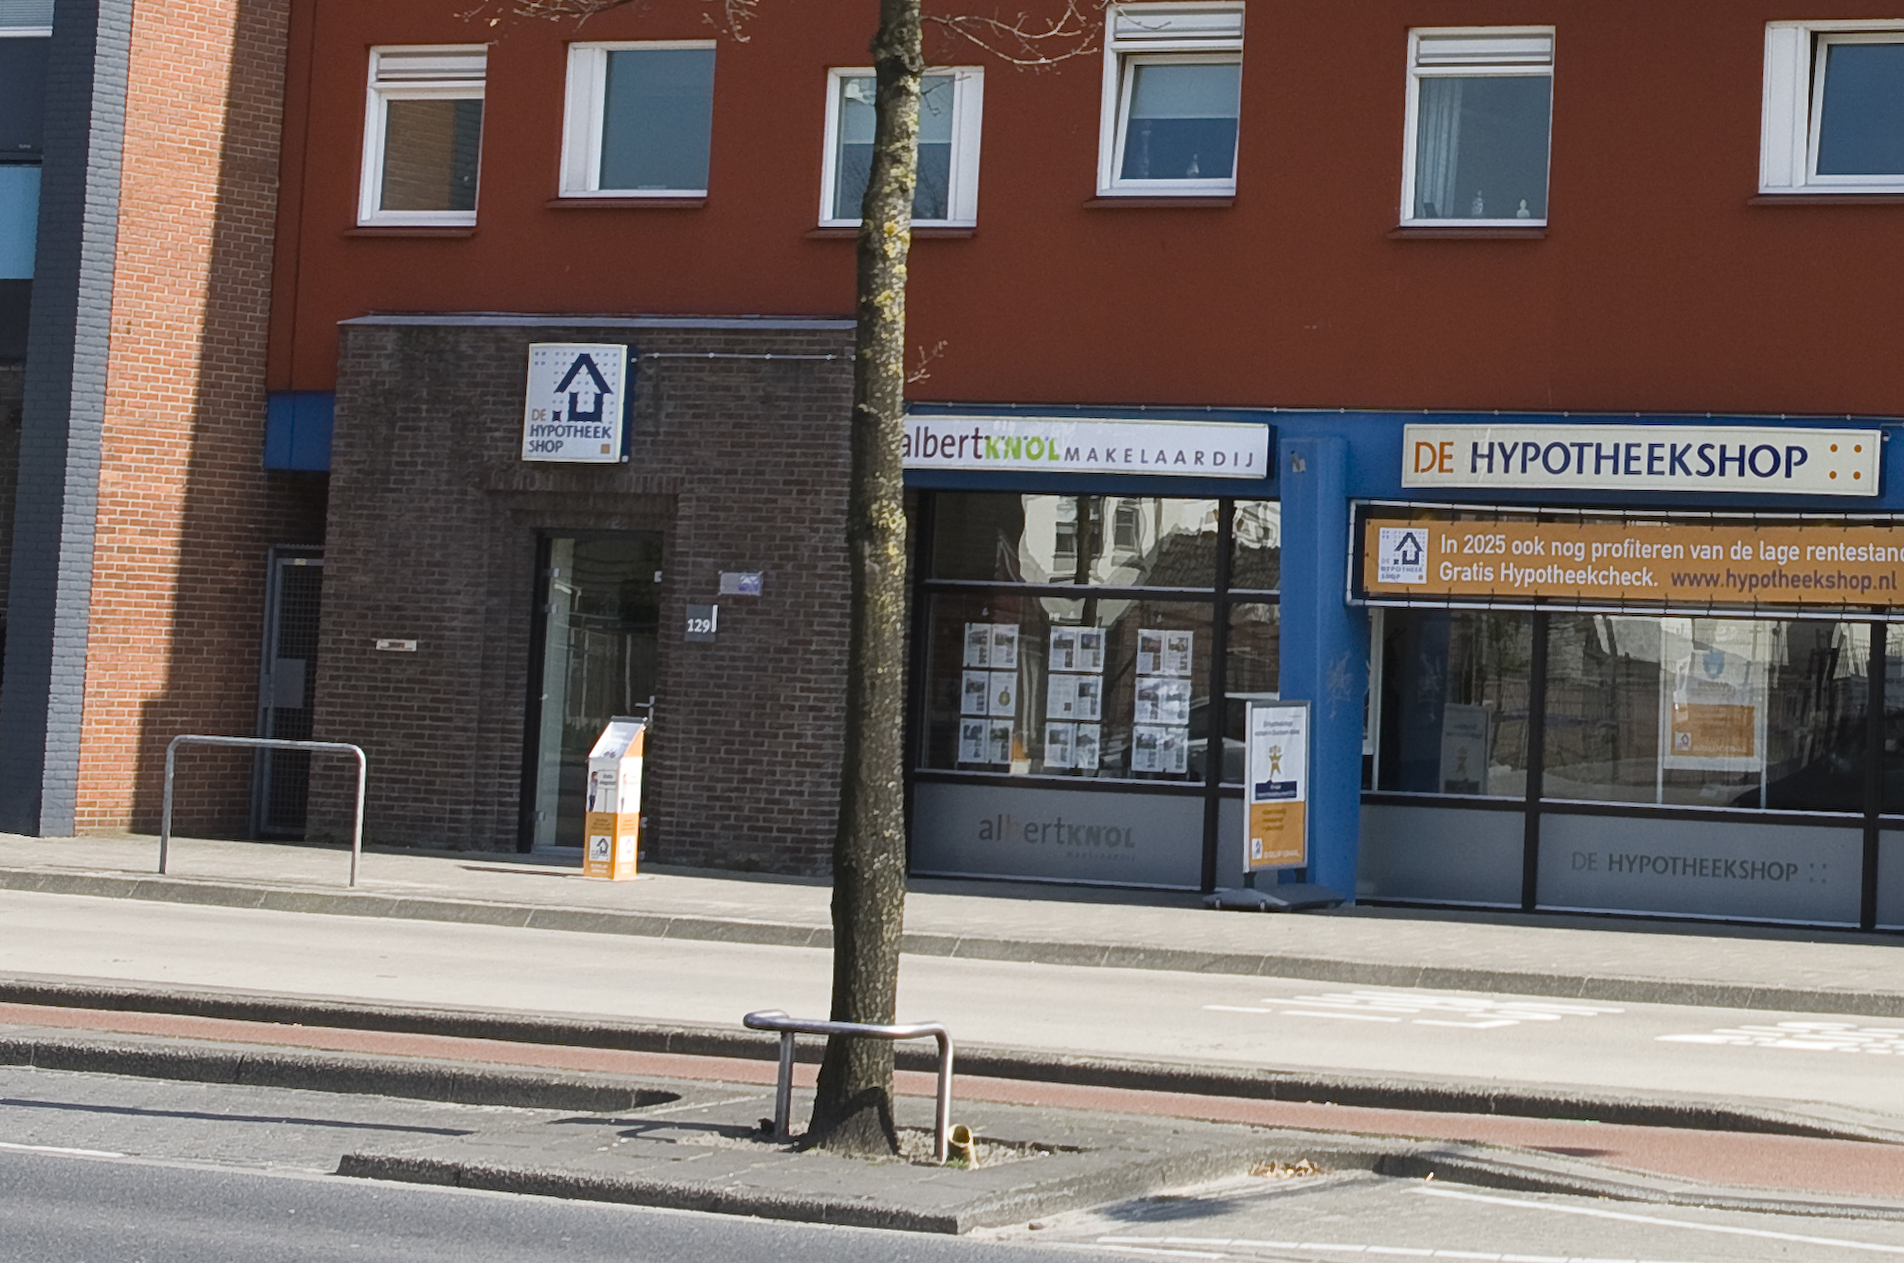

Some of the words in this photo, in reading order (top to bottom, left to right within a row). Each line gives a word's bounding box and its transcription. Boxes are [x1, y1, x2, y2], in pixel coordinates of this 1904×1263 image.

[531, 408, 546, 422] DE
[528, 424, 612, 439] HYPOTHEEK
[528, 439, 564, 453] SHOP
[1064, 446, 1255, 469] MAKELAARDIJ
[1413, 440, 1454, 474] DE
[1469, 440, 1809, 480] HYPOTHEEKSHOP
[1440, 533, 1458, 554] In
[1462, 534, 1506, 555] 2025
[1511, 535, 1546, 556] ook
[1551, 539, 1586, 562] nog
[1591, 537, 1685, 563] profiteren
[1690, 542, 1724, 561] van
[1730, 539, 1754, 561] de
[1759, 540, 1801, 566] lage
[1439, 560, 1495, 583] Gratis
[1500, 561, 1659, 588] Hypotheekcheck.
[1671, 567, 1898, 594] www.hypotheekshop.nl
[687, 618, 711, 634] 129
[1571, 851, 1598, 872] DE
[1607, 853, 1799, 882] HYPOTHEEKSHOP
